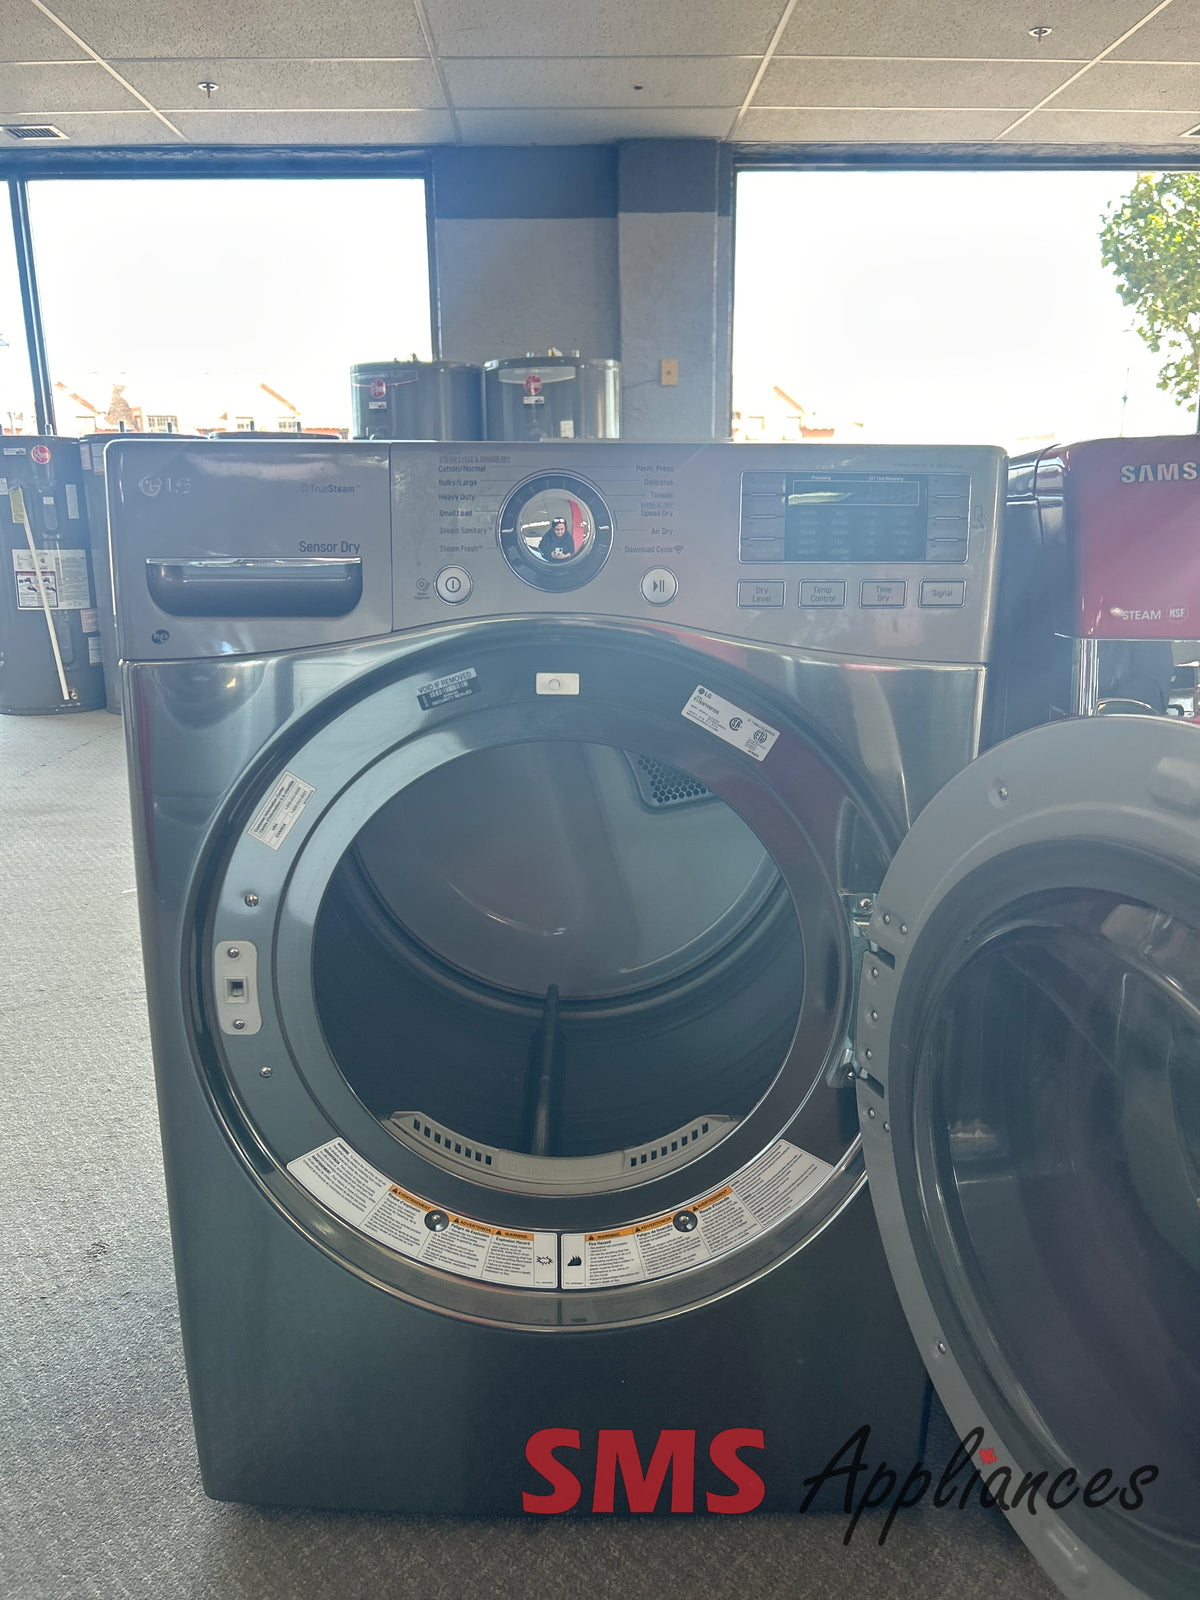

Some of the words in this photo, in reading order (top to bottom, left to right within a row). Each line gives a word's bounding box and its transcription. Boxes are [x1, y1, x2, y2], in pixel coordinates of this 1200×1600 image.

[656, 464, 674, 472] Press
[438, 479, 477, 487] Bulky/Large
[651, 491, 674, 499] Towels
[439, 509, 458, 517] Small
[458, 509, 472, 517] Load
[662, 510, 673, 518] Dry
[662, 528, 674, 536] Dry
[299, 540, 338, 552] Sensor
[340, 540, 360, 554] Dry
[656, 546, 673, 554] Cycle
[755, 586, 768, 596] Dry
[876, 586, 892, 594] Time
[932, 589, 953, 598] Signal
[752, 594, 771, 603] Level
[810, 594, 836, 603] Control
[877, 594, 890, 603] Dry
[1122, 610, 1162, 620] STEAM
[1169, 607, 1185, 618] NSF
[418, 683, 433, 694] VOID
[434, 679, 441, 688] IF
[441, 671, 472, 686] REMOVED
[460, 1220, 490, 1231] ADVERTENCIA
[641, 1218, 671, 1228] ADVERTENCIA
